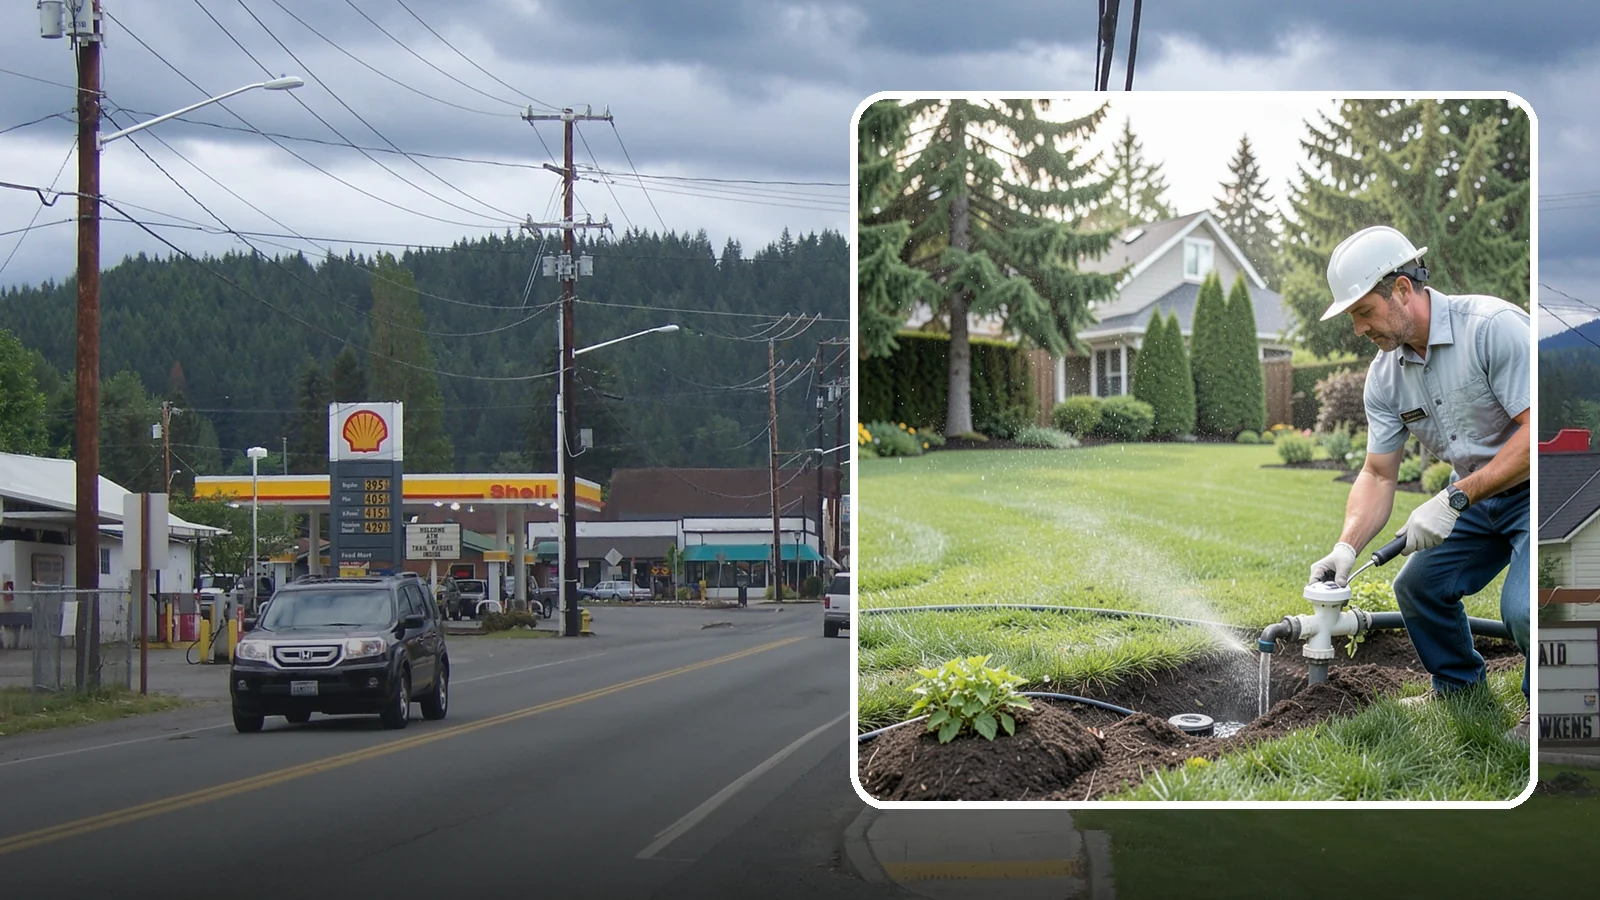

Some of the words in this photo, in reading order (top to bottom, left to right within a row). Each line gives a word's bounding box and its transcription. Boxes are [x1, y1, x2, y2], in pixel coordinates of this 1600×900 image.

[366, 480, 383, 490] 395
[490, 484, 547, 499] Shell
[366, 494, 383, 504] 405
[366, 508, 383, 518] 415
[366, 522, 383, 533] 429
